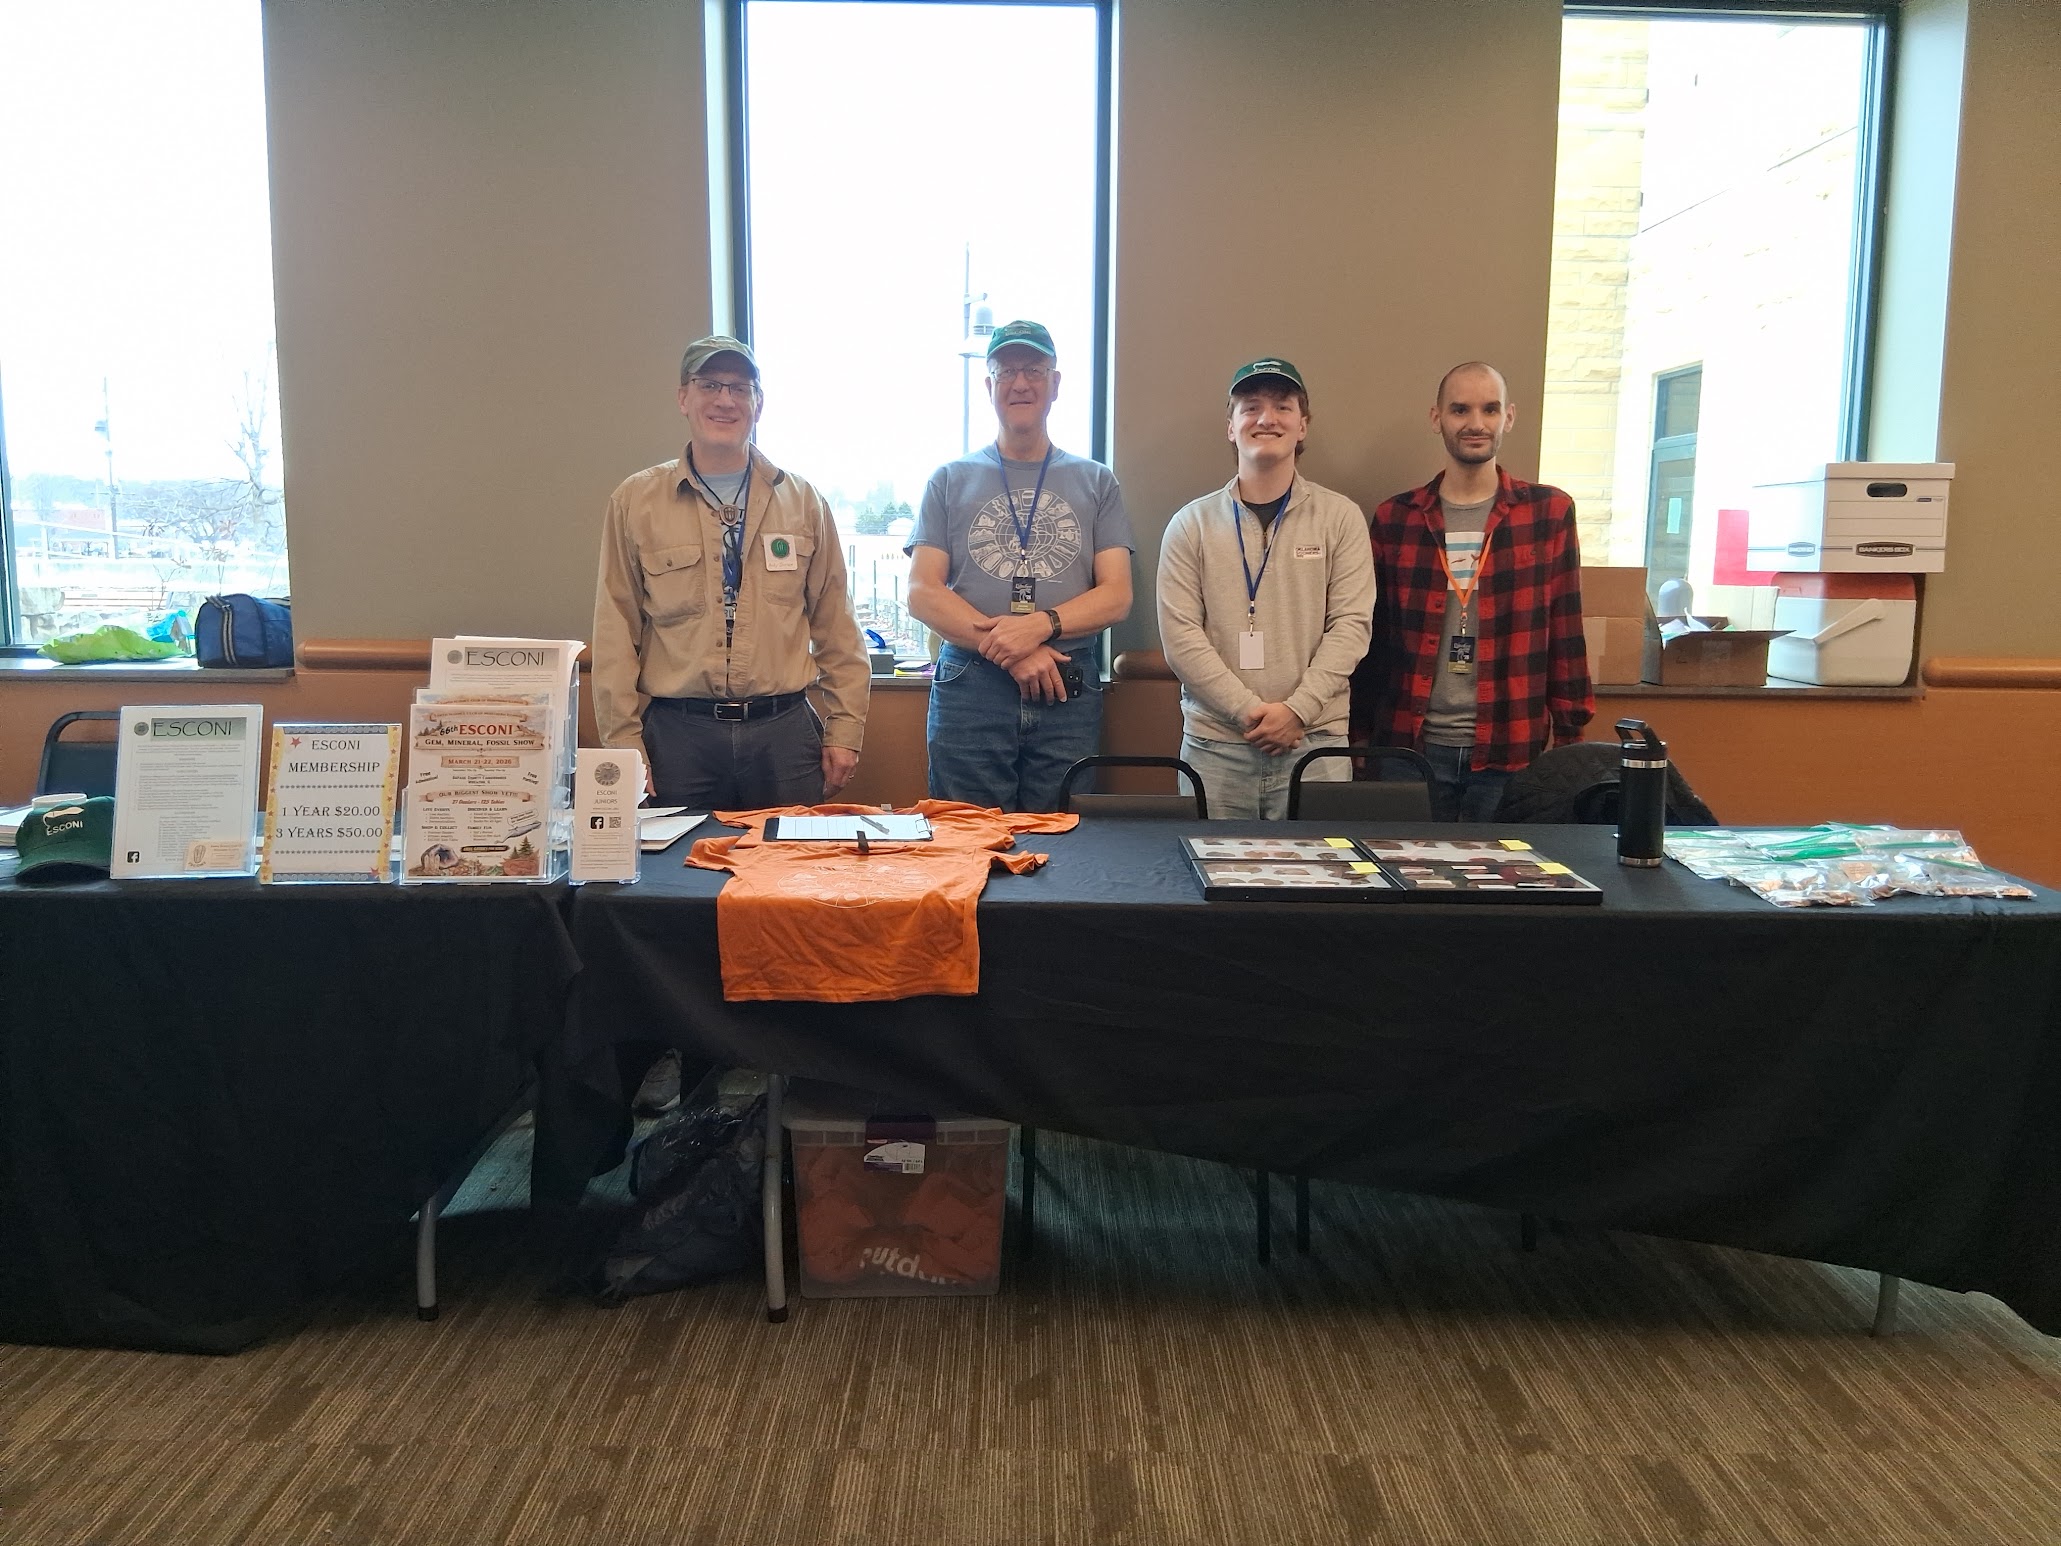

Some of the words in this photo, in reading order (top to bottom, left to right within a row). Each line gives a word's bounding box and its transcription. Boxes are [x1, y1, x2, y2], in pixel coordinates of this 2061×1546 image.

[467, 651, 544, 666] ESCONI
[154, 721, 231, 736] ESCONI
[440, 726, 458, 736] 66th
[460, 725, 513, 735] ESCONI
[312, 740, 360, 750] ESCONI
[289, 762, 380, 773] MEMBERSHIP
[283, 808, 286, 816] 1
[294, 806, 330, 816] YEAR
[335, 806, 380, 816] $20.00
[47, 821, 83, 836] ESCONI
[276, 829, 283, 838] 3
[288, 827, 333, 838] YEARS
[337, 828, 383, 838] $50.00
